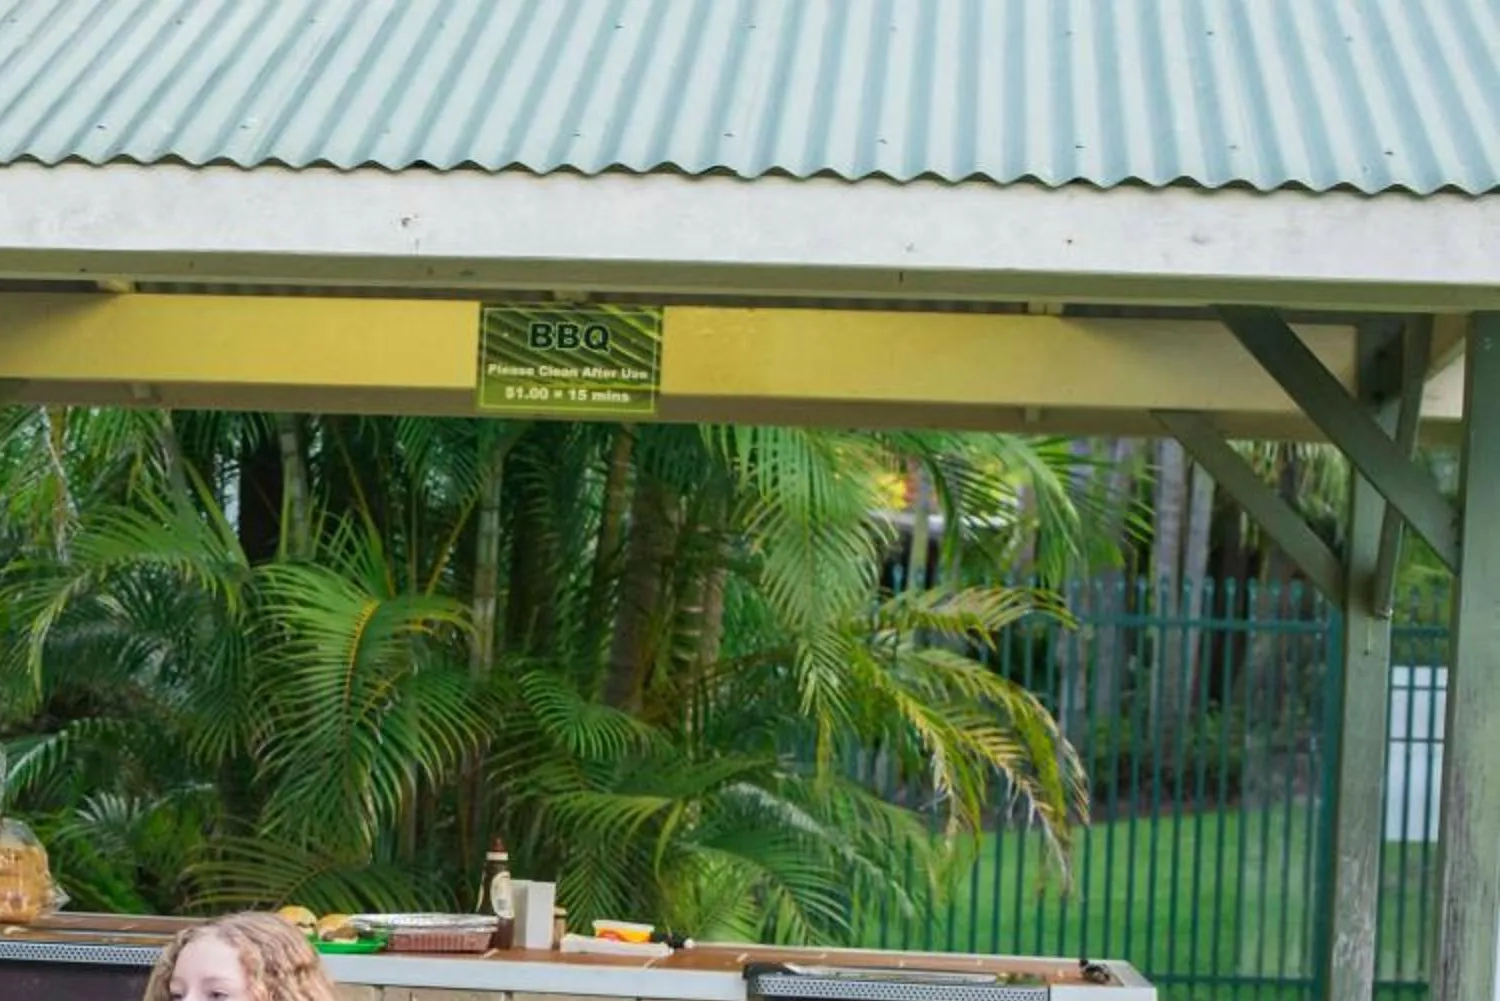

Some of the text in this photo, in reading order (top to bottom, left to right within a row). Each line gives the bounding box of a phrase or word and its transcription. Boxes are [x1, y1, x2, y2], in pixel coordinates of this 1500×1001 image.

[529, 322, 610, 352] BBQ
[487, 363, 648, 379] Please Clean After Use
[568, 388, 588, 401] 15
[591, 389, 631, 402] mins
